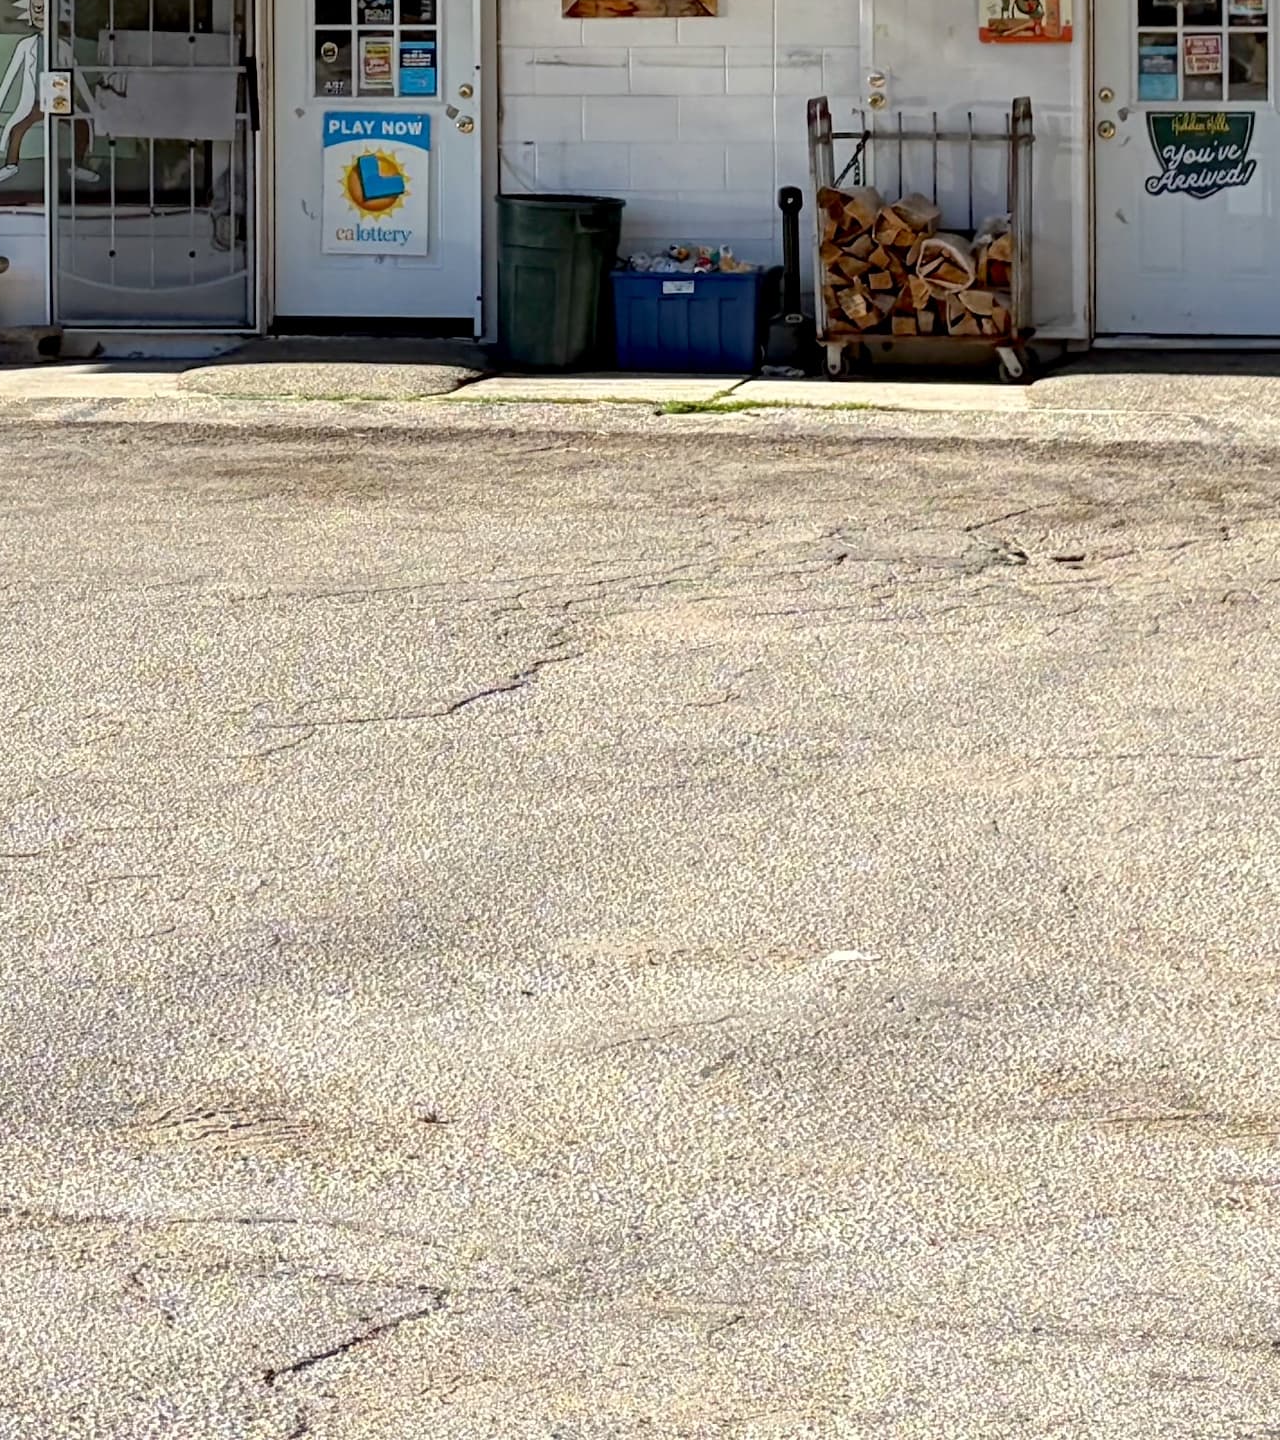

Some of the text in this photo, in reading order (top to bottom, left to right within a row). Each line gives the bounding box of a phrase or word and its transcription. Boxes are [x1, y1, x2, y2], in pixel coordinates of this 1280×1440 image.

[328, 119, 423, 136] PLAY NOW
[1162, 140, 1241, 169] You've
